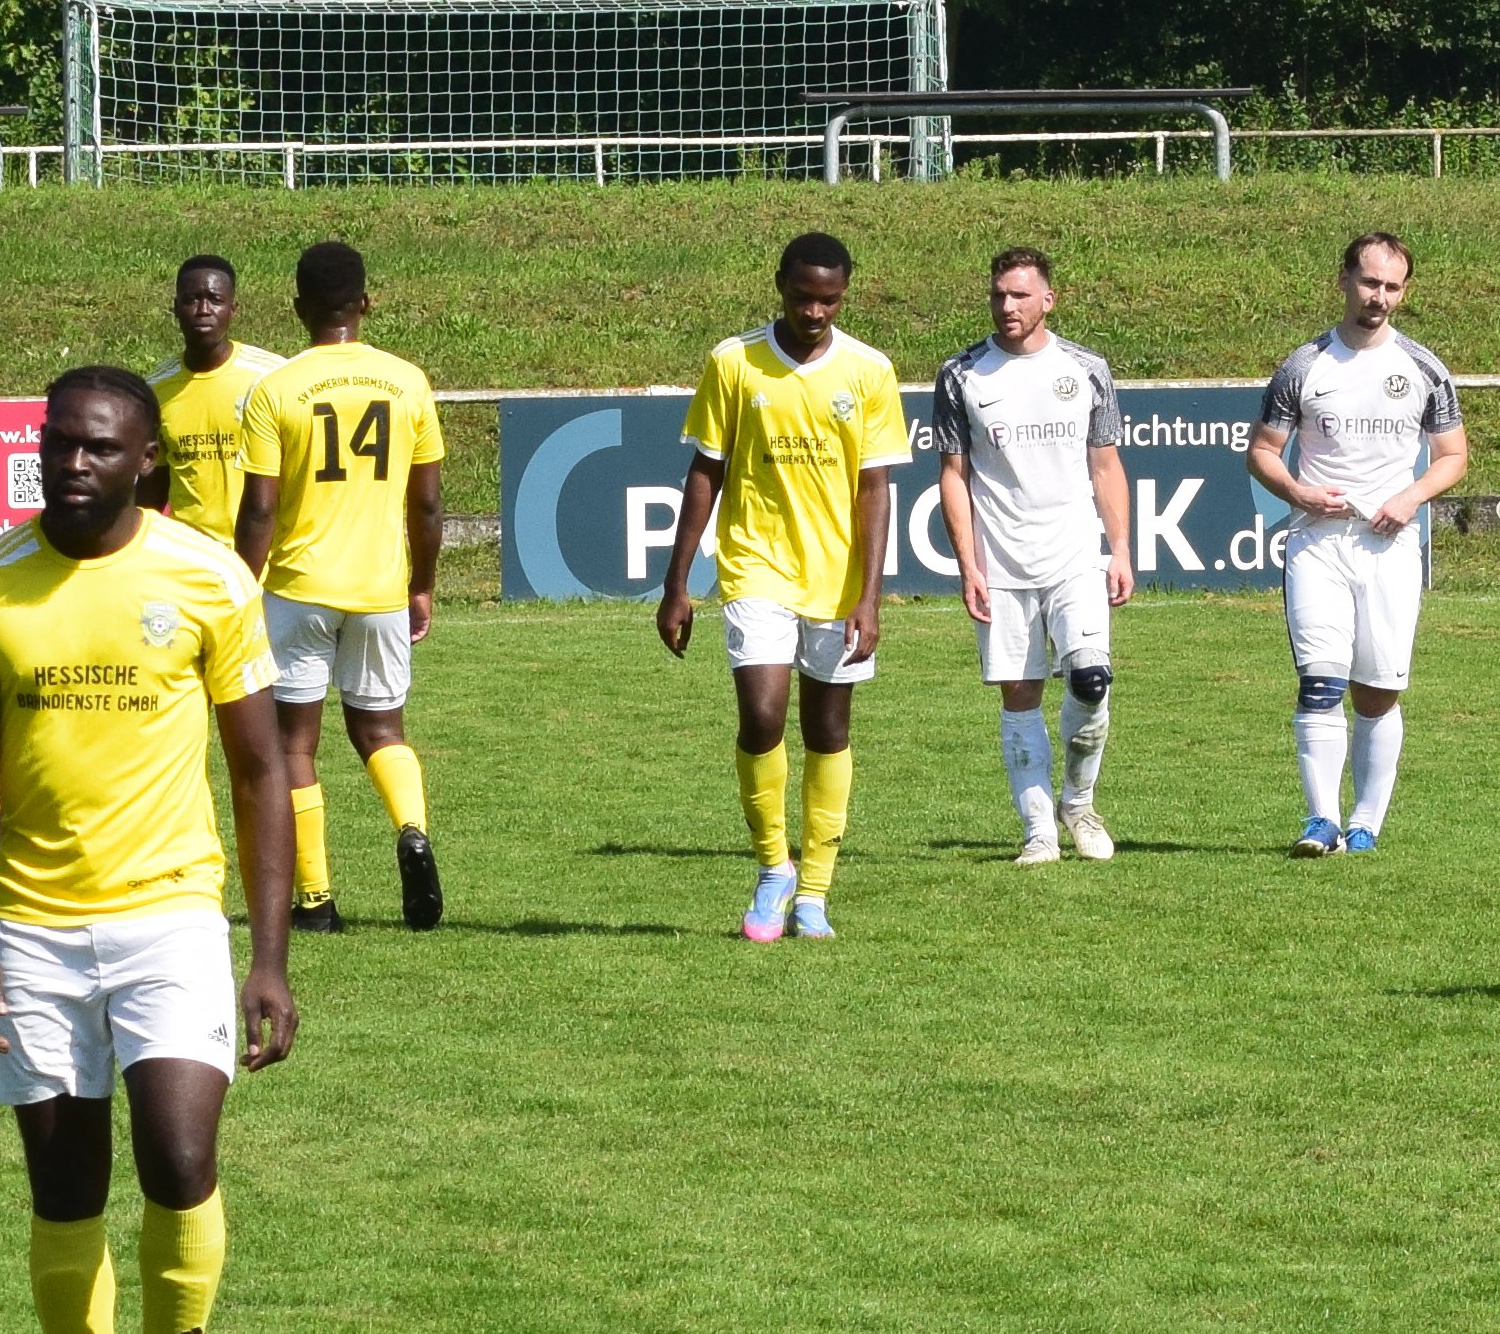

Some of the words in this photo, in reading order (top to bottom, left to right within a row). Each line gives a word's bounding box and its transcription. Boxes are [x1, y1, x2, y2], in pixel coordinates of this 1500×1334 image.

[1016, 421, 1076, 442] FINADO
[1345, 418, 1405, 435] FINADO
[313, 400, 390, 482] 14
[770, 435, 828, 451] HESSISCHE
[34, 665, 139, 686] HESSISCHE
[16, 694, 111, 710] BAHNDIENSTE
[117, 694, 159, 711] GMBH
